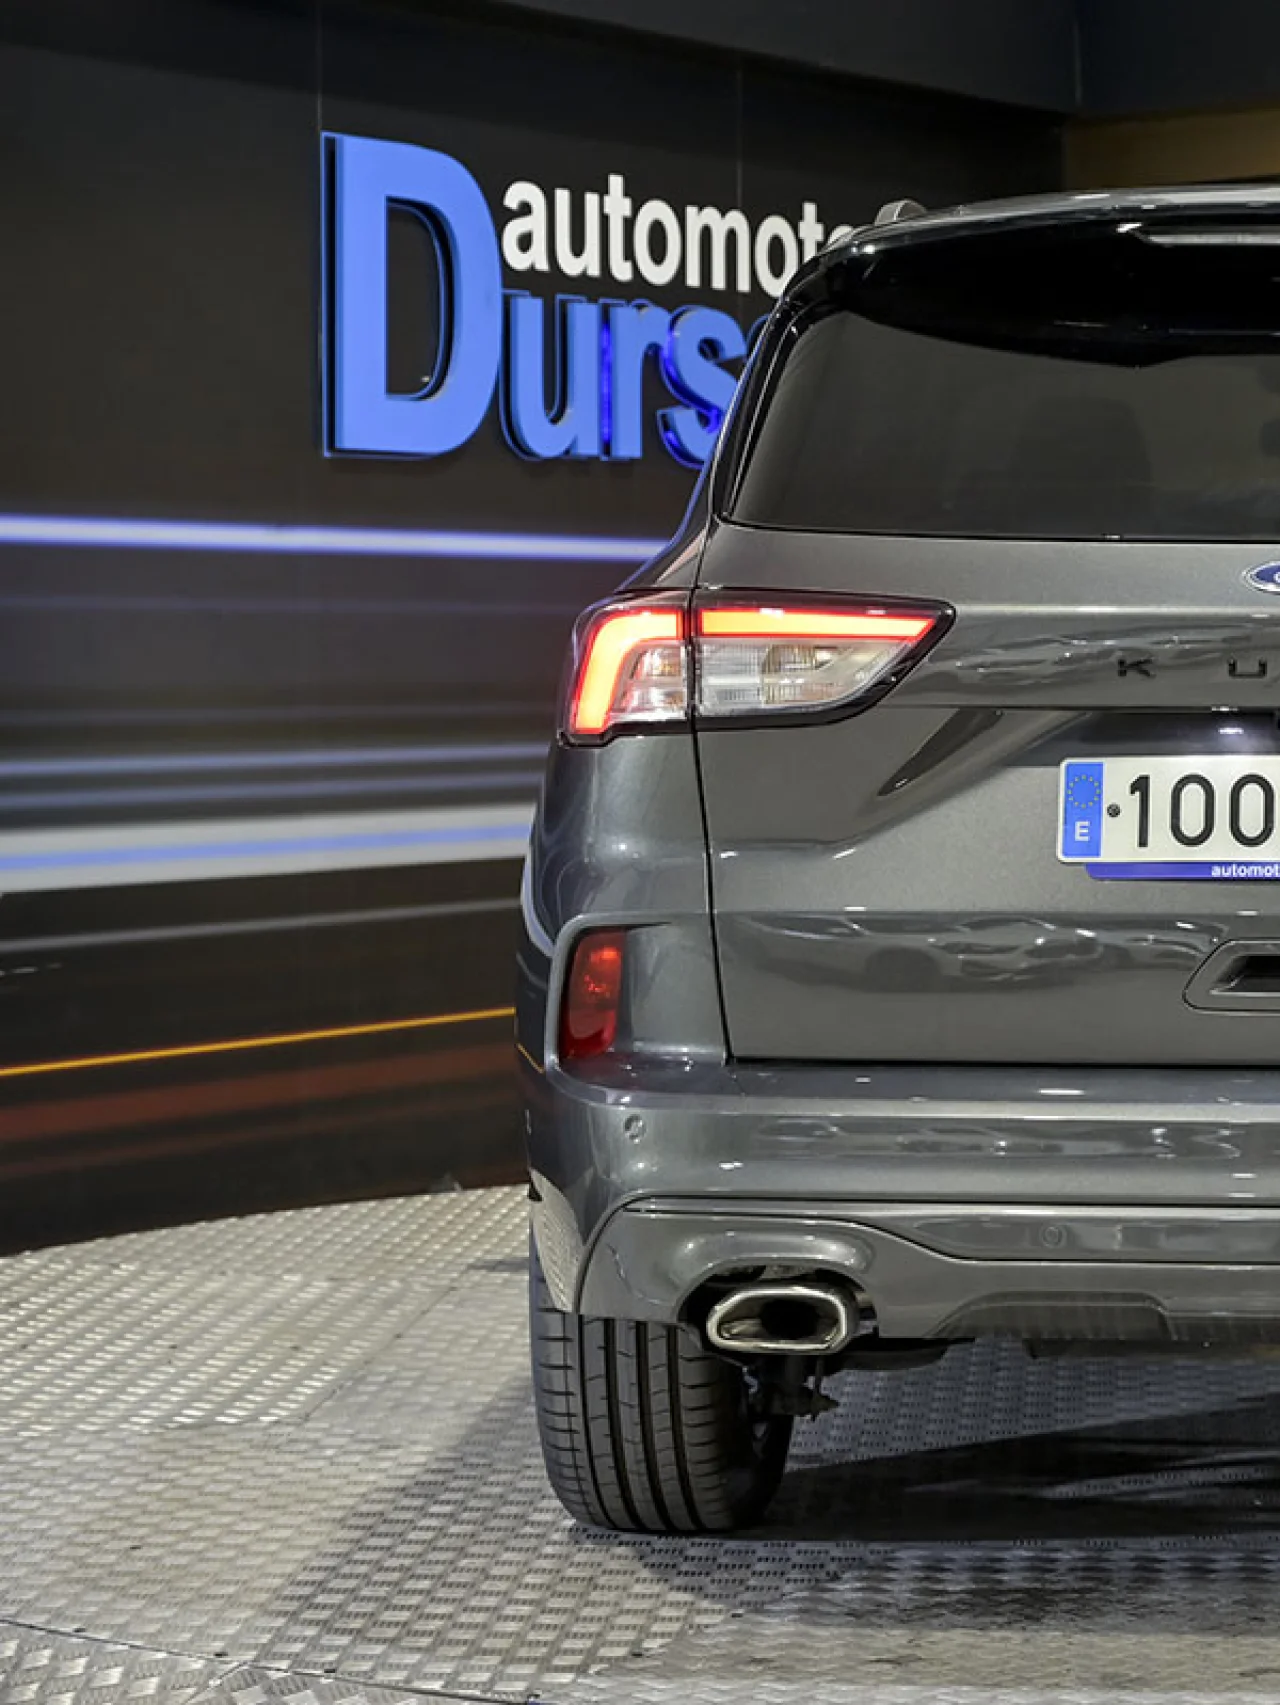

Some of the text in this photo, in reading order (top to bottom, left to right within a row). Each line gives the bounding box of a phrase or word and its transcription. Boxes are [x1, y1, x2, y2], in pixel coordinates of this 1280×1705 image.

[502, 173, 853, 299] automot
[321, 131, 770, 470] Durs
[1074, 820, 1090, 841] E
